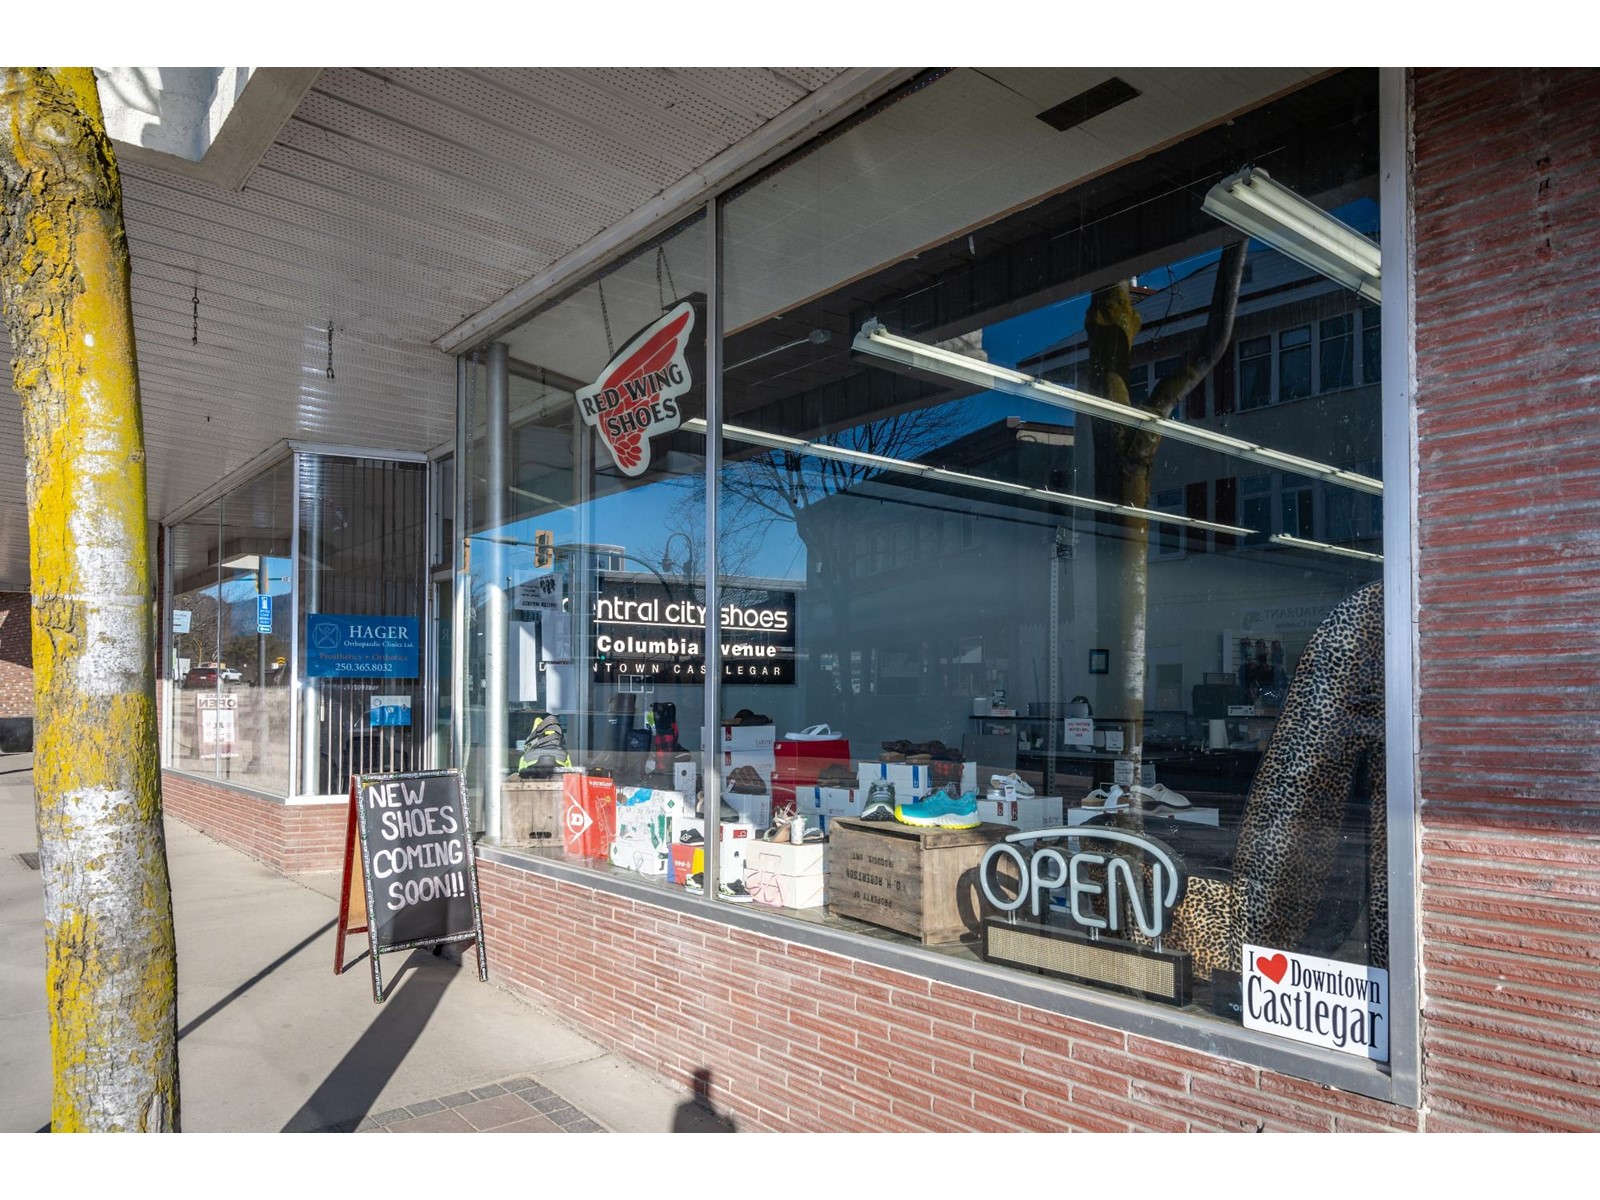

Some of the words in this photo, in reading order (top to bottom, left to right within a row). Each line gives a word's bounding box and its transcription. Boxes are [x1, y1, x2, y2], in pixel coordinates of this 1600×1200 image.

[582, 387, 620, 417] RED
[624, 362, 684, 402] WING
[607, 398, 677, 437] SHOES
[349, 625, 409, 640] HAGER
[721, 604, 788, 628] shoes
[343, 640, 380, 649] Orthopaedic
[382, 640, 402, 648] Clinics
[597, 635, 699, 655] Columbia
[721, 643, 777, 658] venue
[335, 662, 393, 672] 250.365.8032
[673, 664, 781, 676] CASLEGAR
[368, 781, 426, 810] NEW
[381, 805, 458, 841] SHOES
[373, 839, 464, 879] COMING
[387, 871, 466, 911] SOON!!
[979, 842, 1163, 938] OPEN
[1249, 950, 1254, 972] I
[1290, 958, 1381, 1005] Downtown
[1247, 974, 1383, 1048] Castlegar
